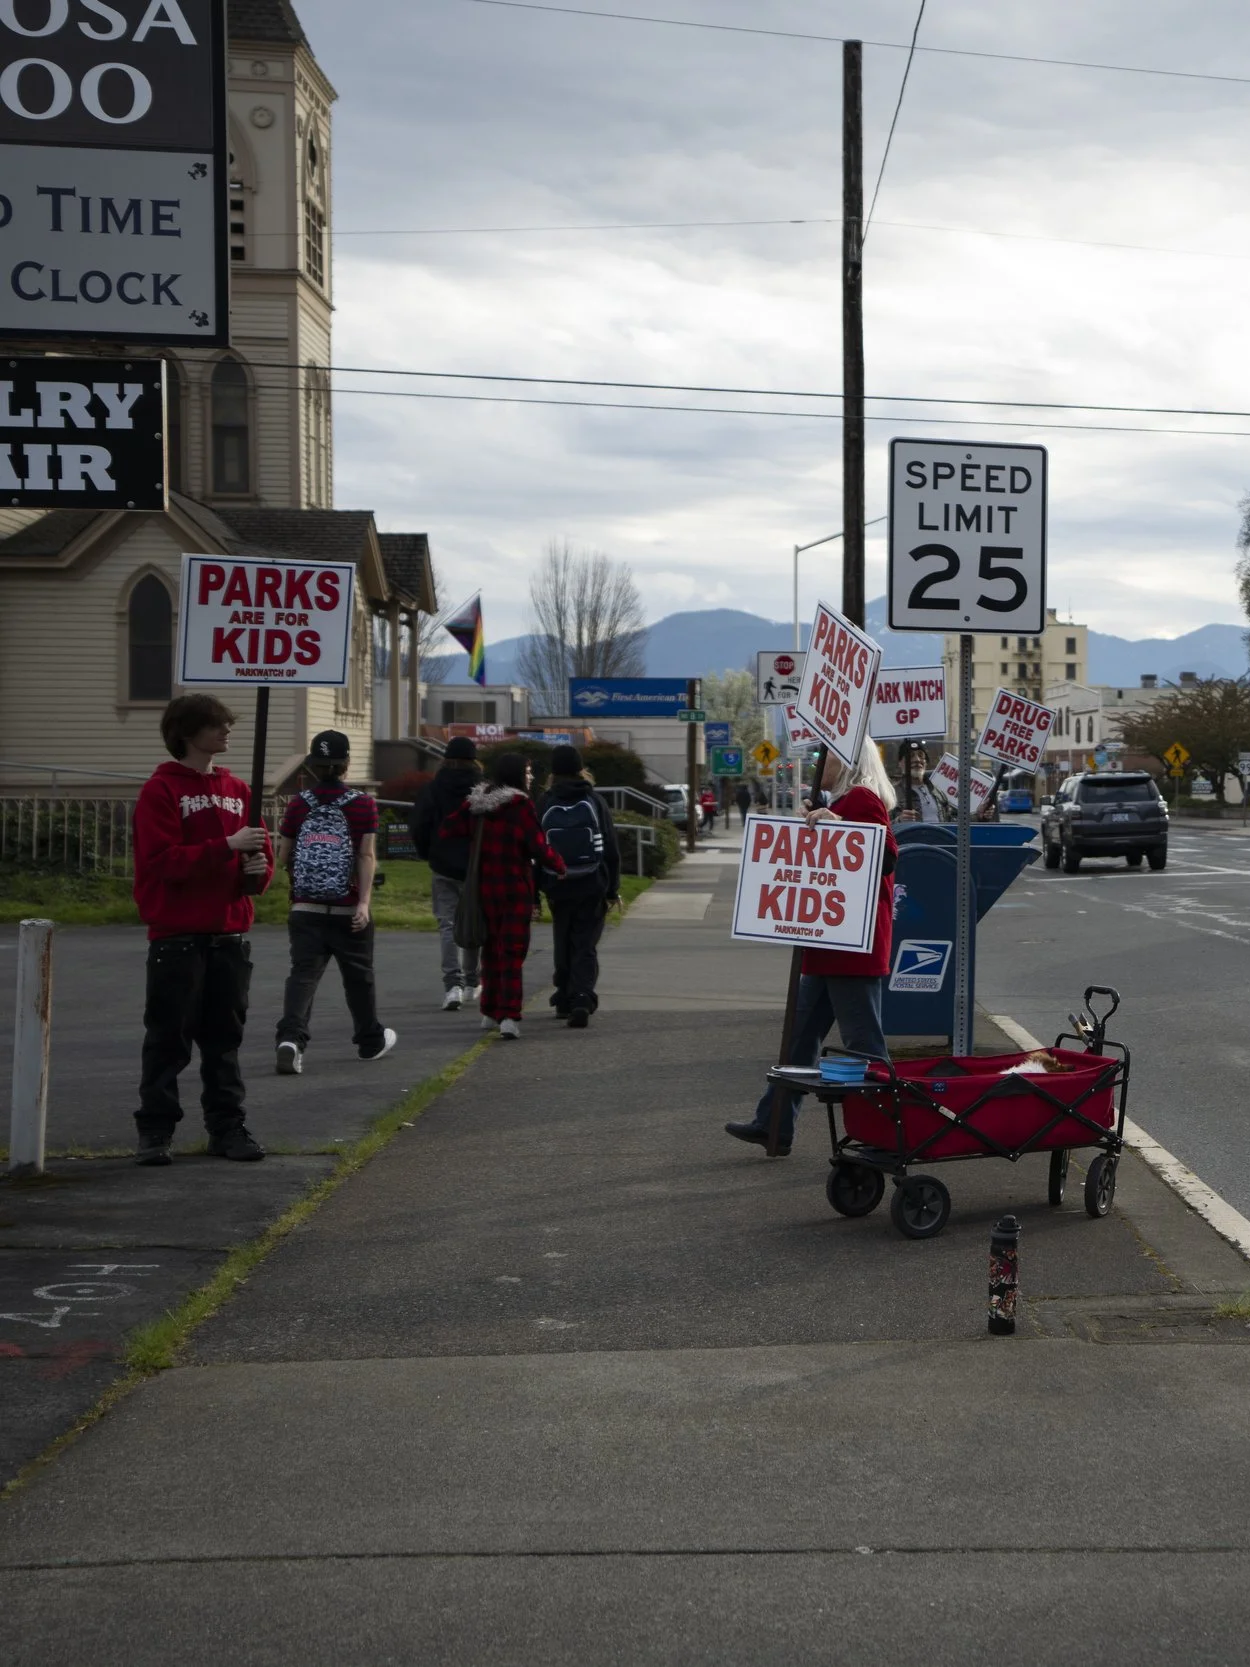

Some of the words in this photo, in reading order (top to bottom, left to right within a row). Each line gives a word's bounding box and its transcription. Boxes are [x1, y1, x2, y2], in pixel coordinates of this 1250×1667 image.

[905, 460, 1032, 494] SPEED
[918, 502, 1018, 535] LIMIT
[198, 564, 341, 612] PARKS
[907, 543, 1028, 613] 25
[228, 611, 265, 625] ARE
[274, 612, 309, 627] FOR
[211, 627, 321, 666] KIDS
[813, 612, 869, 690] PARKS
[235, 667, 285, 678] PARKWATCH
[774, 661, 795, 670] STOP
[820, 662, 835, 684] ARE
[836, 674, 850, 698] FOR
[808, 672, 851, 737] KIDS
[875, 681, 901, 704] ARK
[903, 679, 943, 703] WATCH
[896, 708, 920, 725] GP
[996, 694, 1051, 726] DRUG
[983, 728, 1040, 763] PARKS
[1002, 719, 1034, 741] FREE
[751, 823, 866, 873] PARKS
[773, 868, 803, 884] ARE
[808, 871, 838, 887] FOR
[757, 883, 846, 927] KIDS
[774, 924, 814, 937] PARKWATCH
[814, 928, 824, 938] GP
